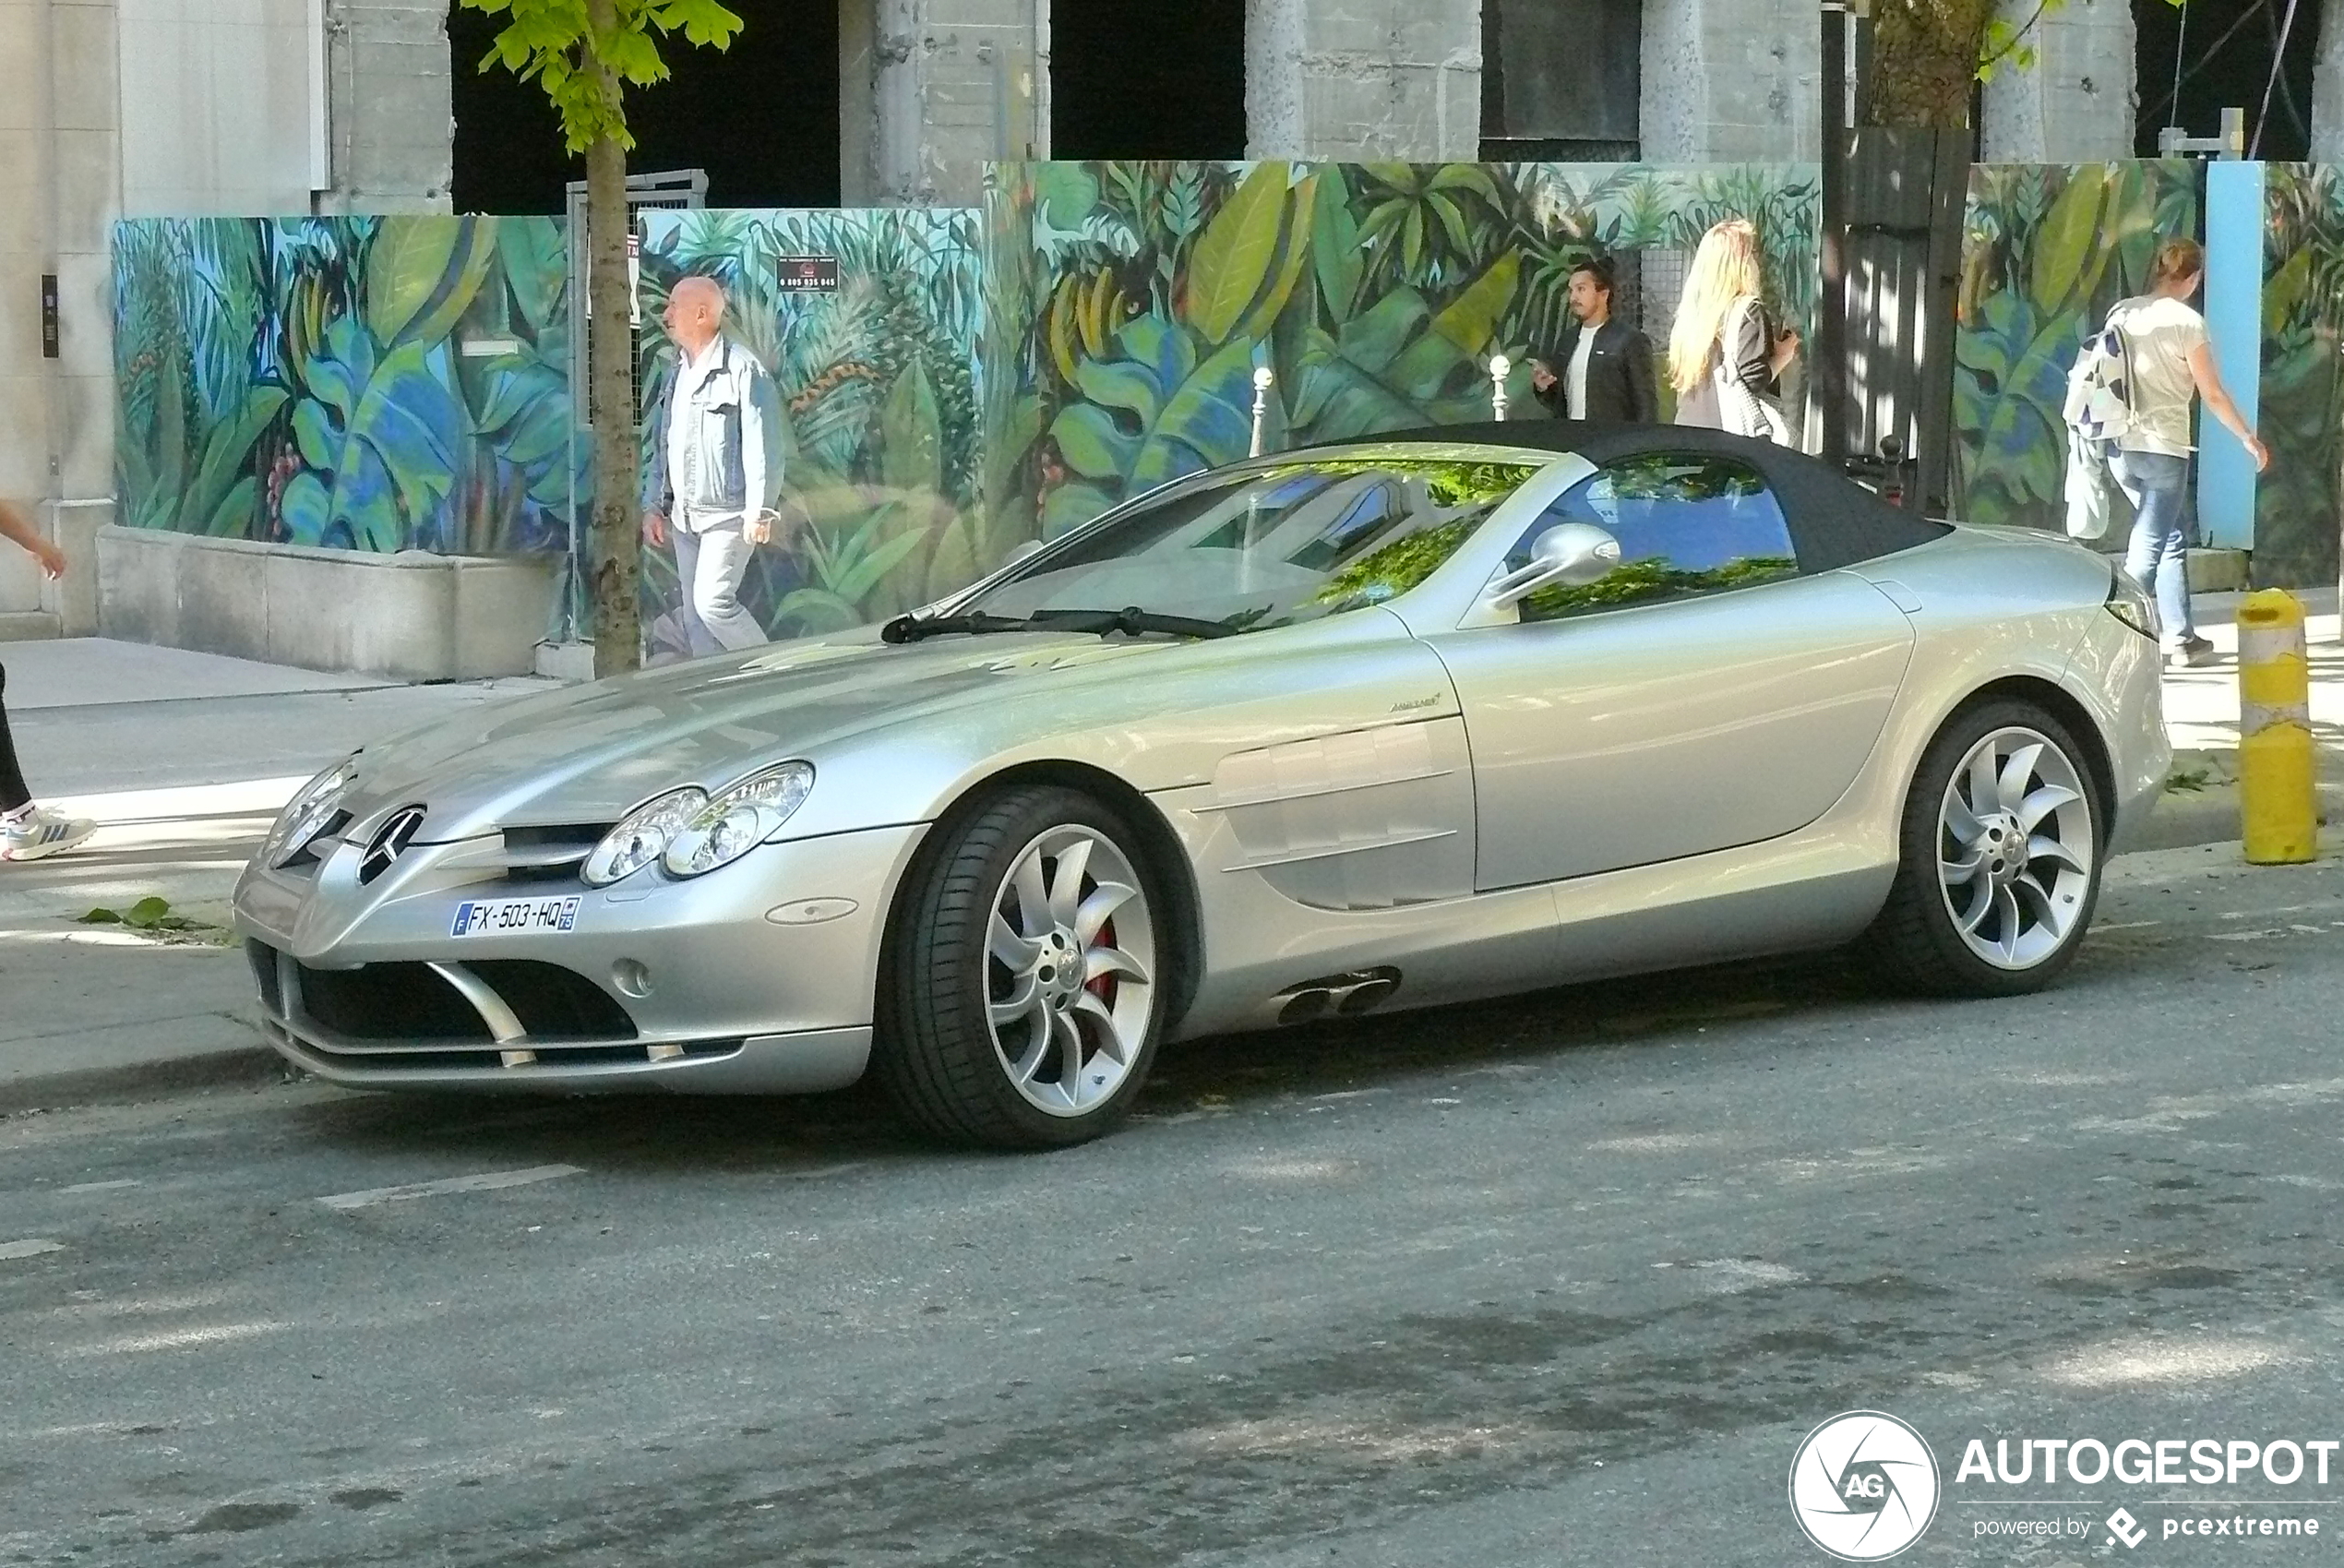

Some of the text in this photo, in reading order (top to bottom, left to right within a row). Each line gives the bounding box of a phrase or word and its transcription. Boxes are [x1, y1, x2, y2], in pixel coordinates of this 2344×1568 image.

[468, 902, 561, 930] FX-503-HQ
[559, 916, 572, 928] 75
[457, 919, 465, 931] F
